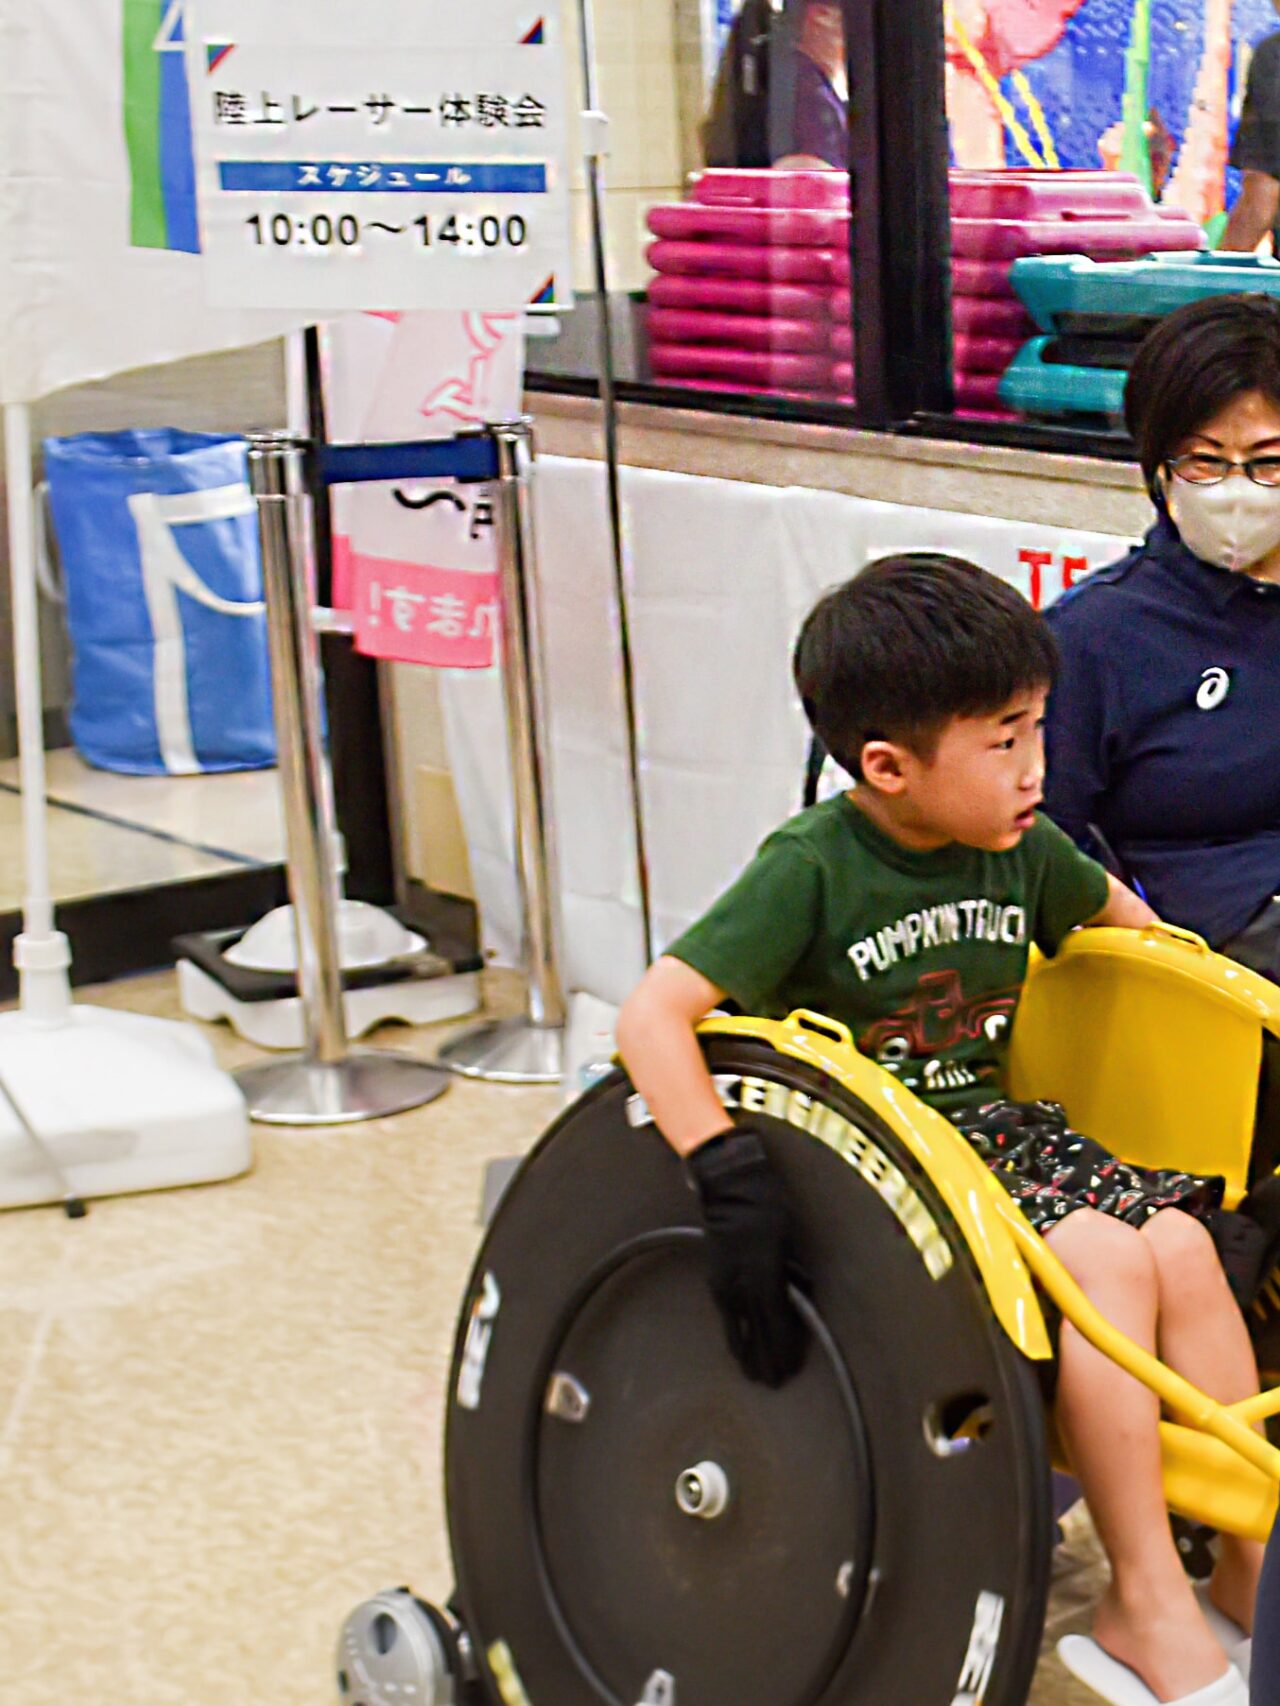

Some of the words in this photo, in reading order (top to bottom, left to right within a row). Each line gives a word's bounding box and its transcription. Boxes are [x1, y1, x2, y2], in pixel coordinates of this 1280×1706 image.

[211, 90, 548, 131] 陸上レーサー体験会
[296, 163, 472, 188] スケジュール
[847, 902, 960, 982] PUMPKIN
